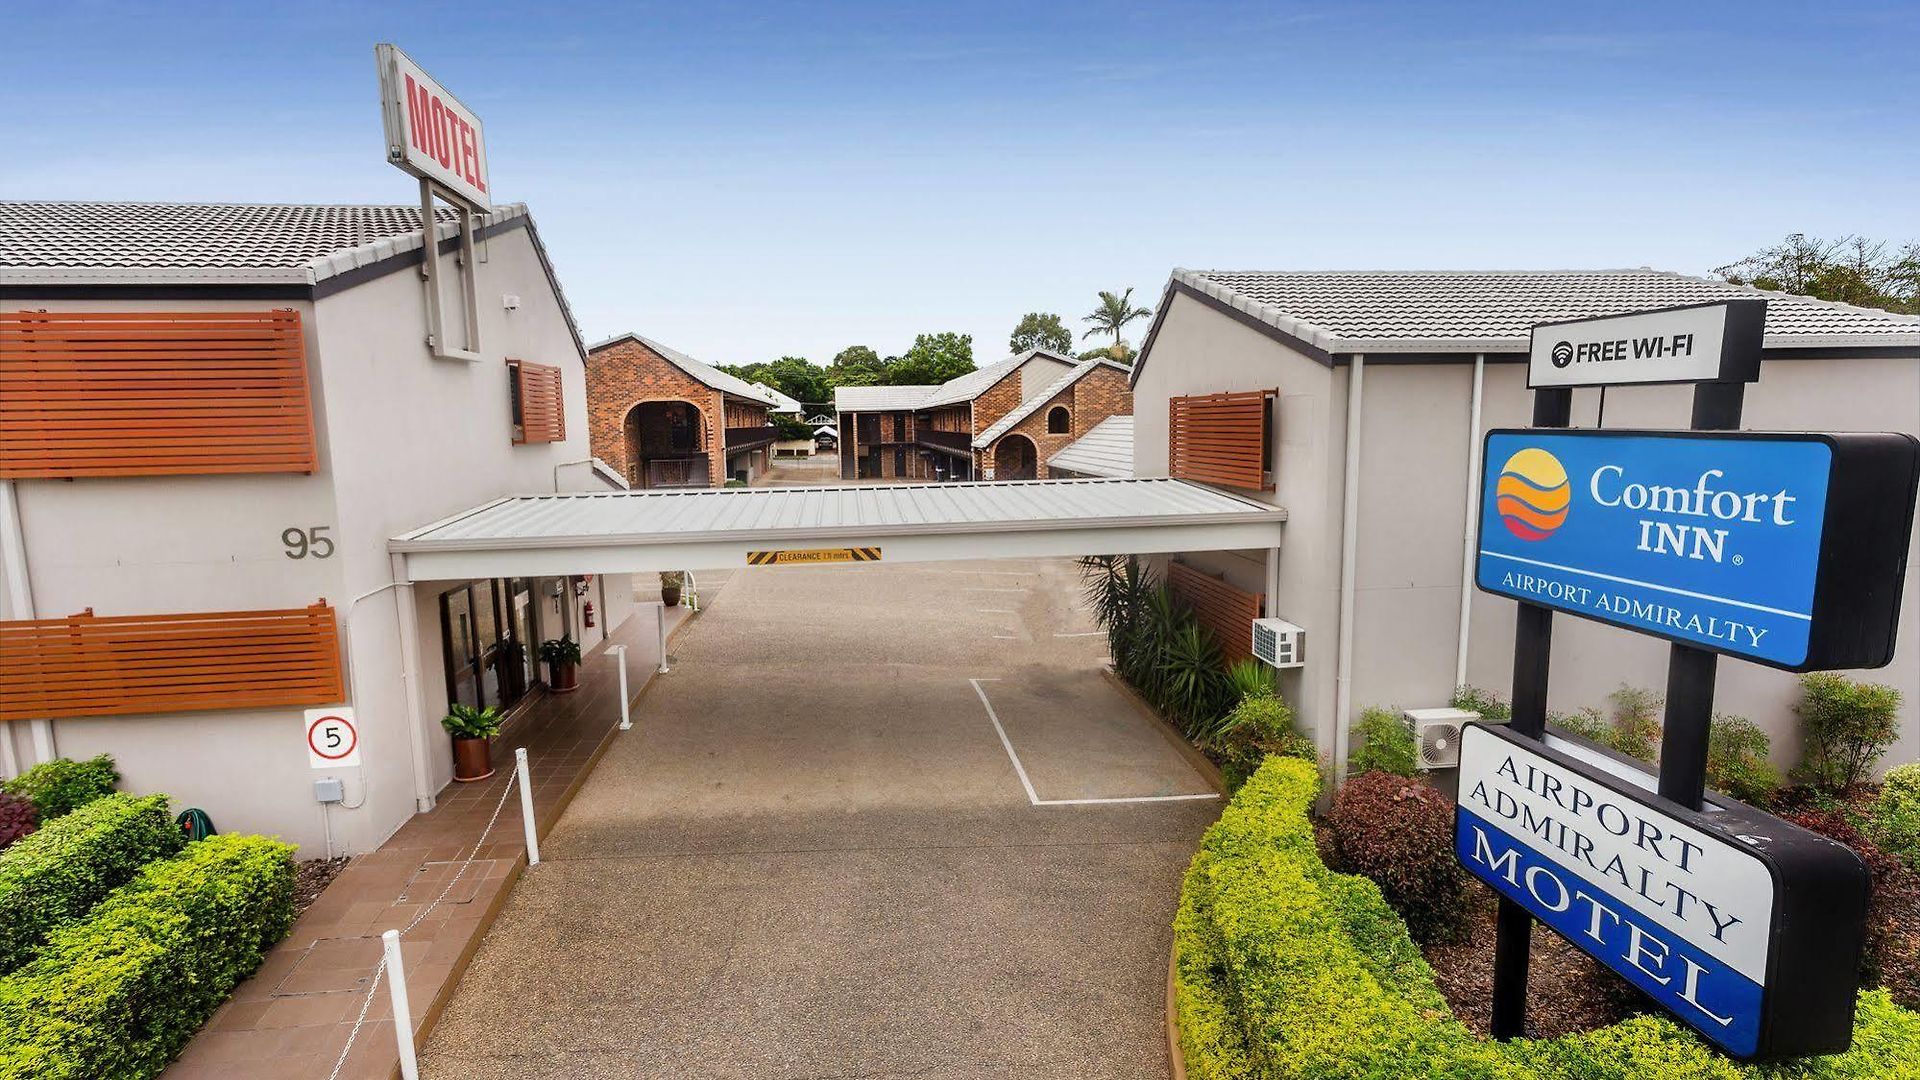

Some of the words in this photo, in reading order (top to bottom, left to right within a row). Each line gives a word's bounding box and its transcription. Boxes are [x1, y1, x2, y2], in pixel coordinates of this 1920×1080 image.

[405, 74, 486, 193] MOTEL
[1576, 339, 1627, 363] FREE
[1631, 334, 1693, 359] WI-FI
[1590, 465, 1796, 526] Comfort
[281, 525, 334, 560] 95
[779, 552, 821, 562] CLEARANCE
[1501, 570, 1592, 605] AIRPORT
[1595, 590, 1769, 649] ADMIRALTY
[326, 727, 341, 748] 5
[1496, 754, 1704, 875] AIRPORT
[1469, 780, 1743, 945] ADMIRALTY
[1471, 825, 1733, 1028] MOTEL
